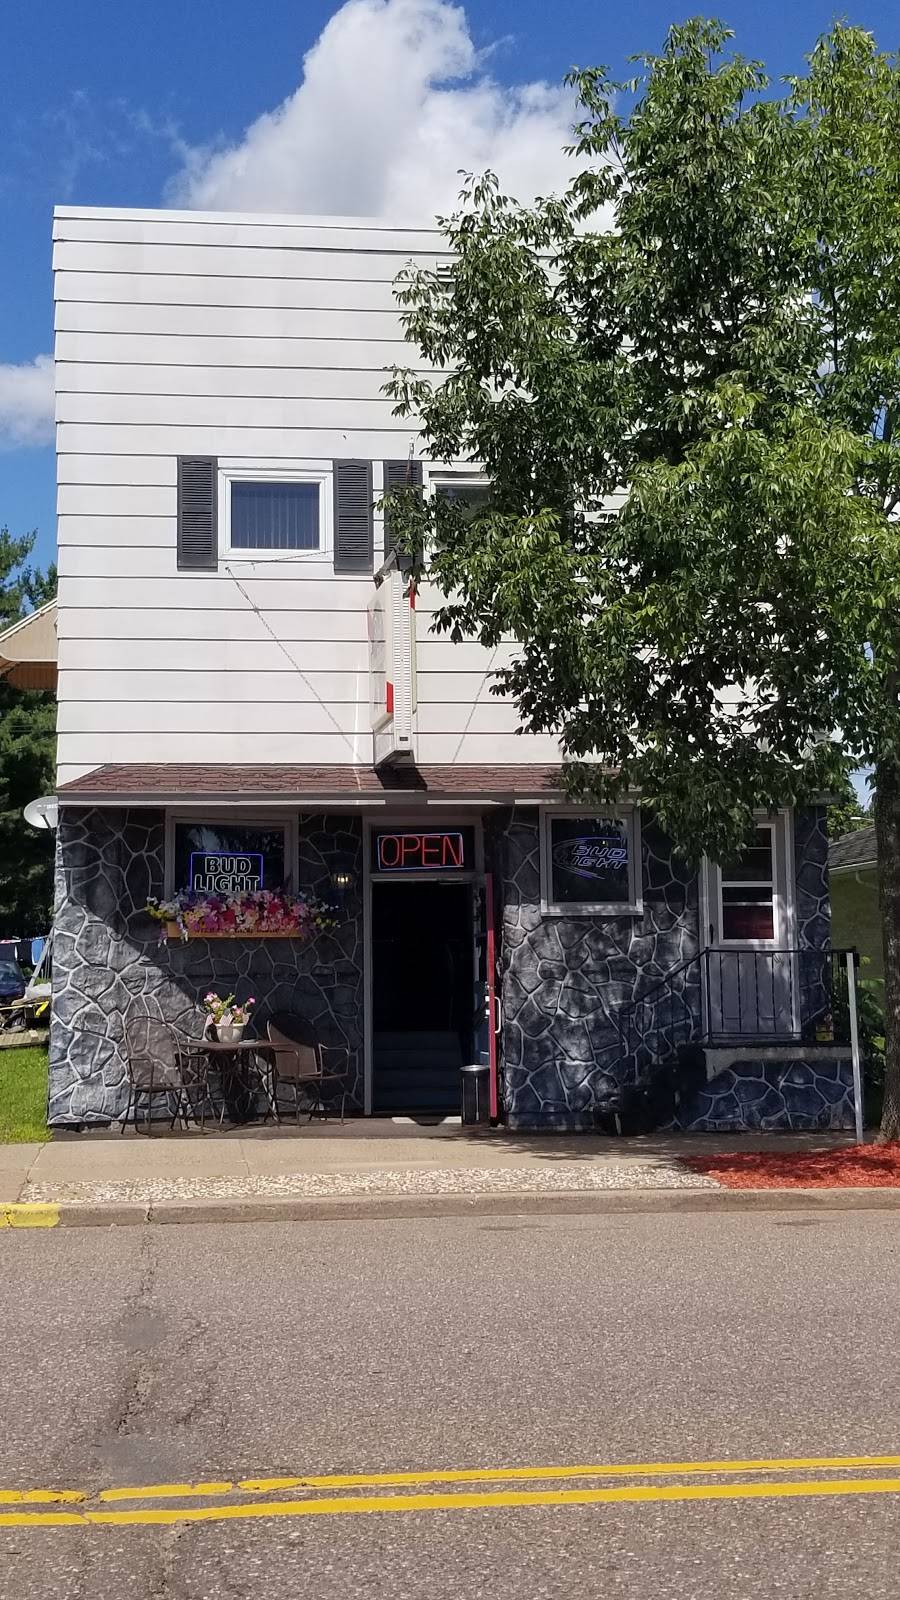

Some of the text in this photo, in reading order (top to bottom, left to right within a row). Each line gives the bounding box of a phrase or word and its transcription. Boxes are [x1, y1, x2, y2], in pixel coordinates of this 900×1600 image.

[381, 835, 462, 866] OPEN
[571, 844, 627, 859] BUD
[205, 857, 251, 875] BUD
[570, 855, 629, 869] IGHT
[194, 874, 260, 893] LIGHT
